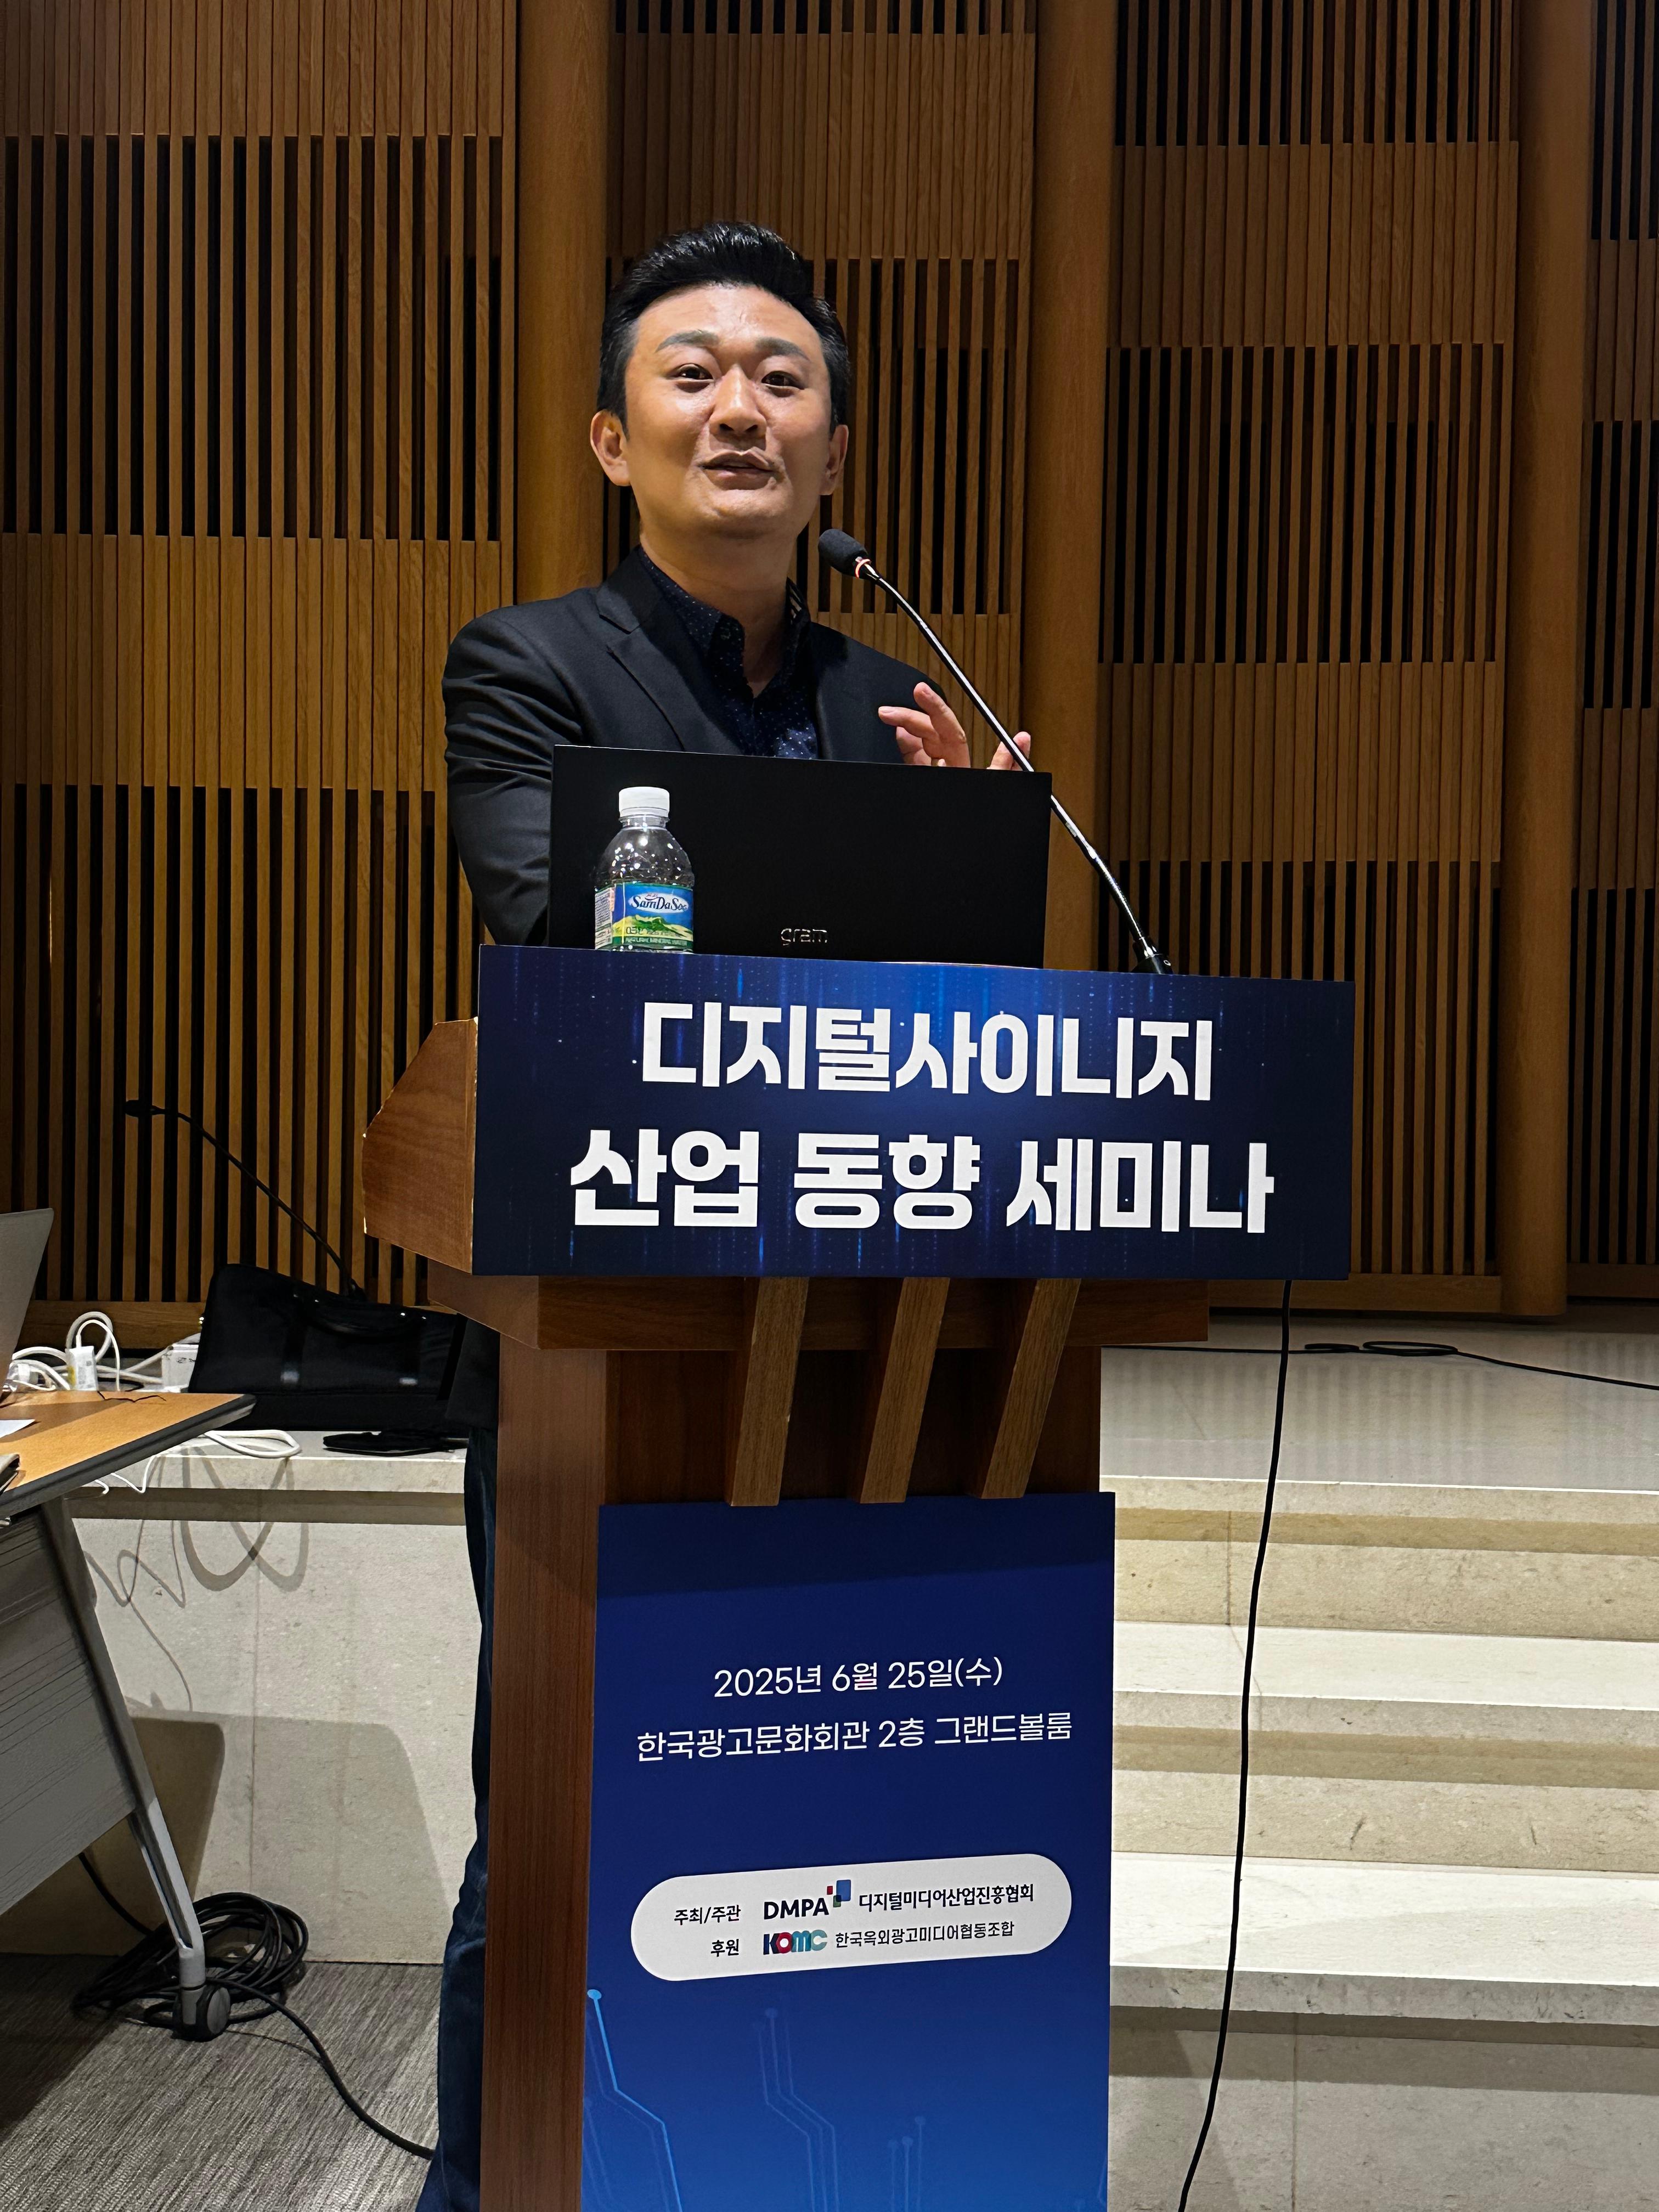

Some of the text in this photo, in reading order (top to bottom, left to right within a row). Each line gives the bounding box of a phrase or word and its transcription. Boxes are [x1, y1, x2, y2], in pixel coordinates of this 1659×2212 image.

[780, 928, 828, 946] gram
[642, 1001, 1213, 1102] 디지털사이니지
[570, 1128, 1275, 1234] 산업 동향 세미나
[714, 1656, 1003, 1697] 2025년 6월 25일(수)
[637, 1712, 1073, 1762] 한국광고문화회관 2층 그랜드볼룸
[674, 1883, 1034, 1925] 주최/주관 DMPA 디지털미디어산업진흥협회
[710, 1939, 739, 1957] 후원
[836, 1921, 1014, 1948] 한국옥외광고미디어협동조합
